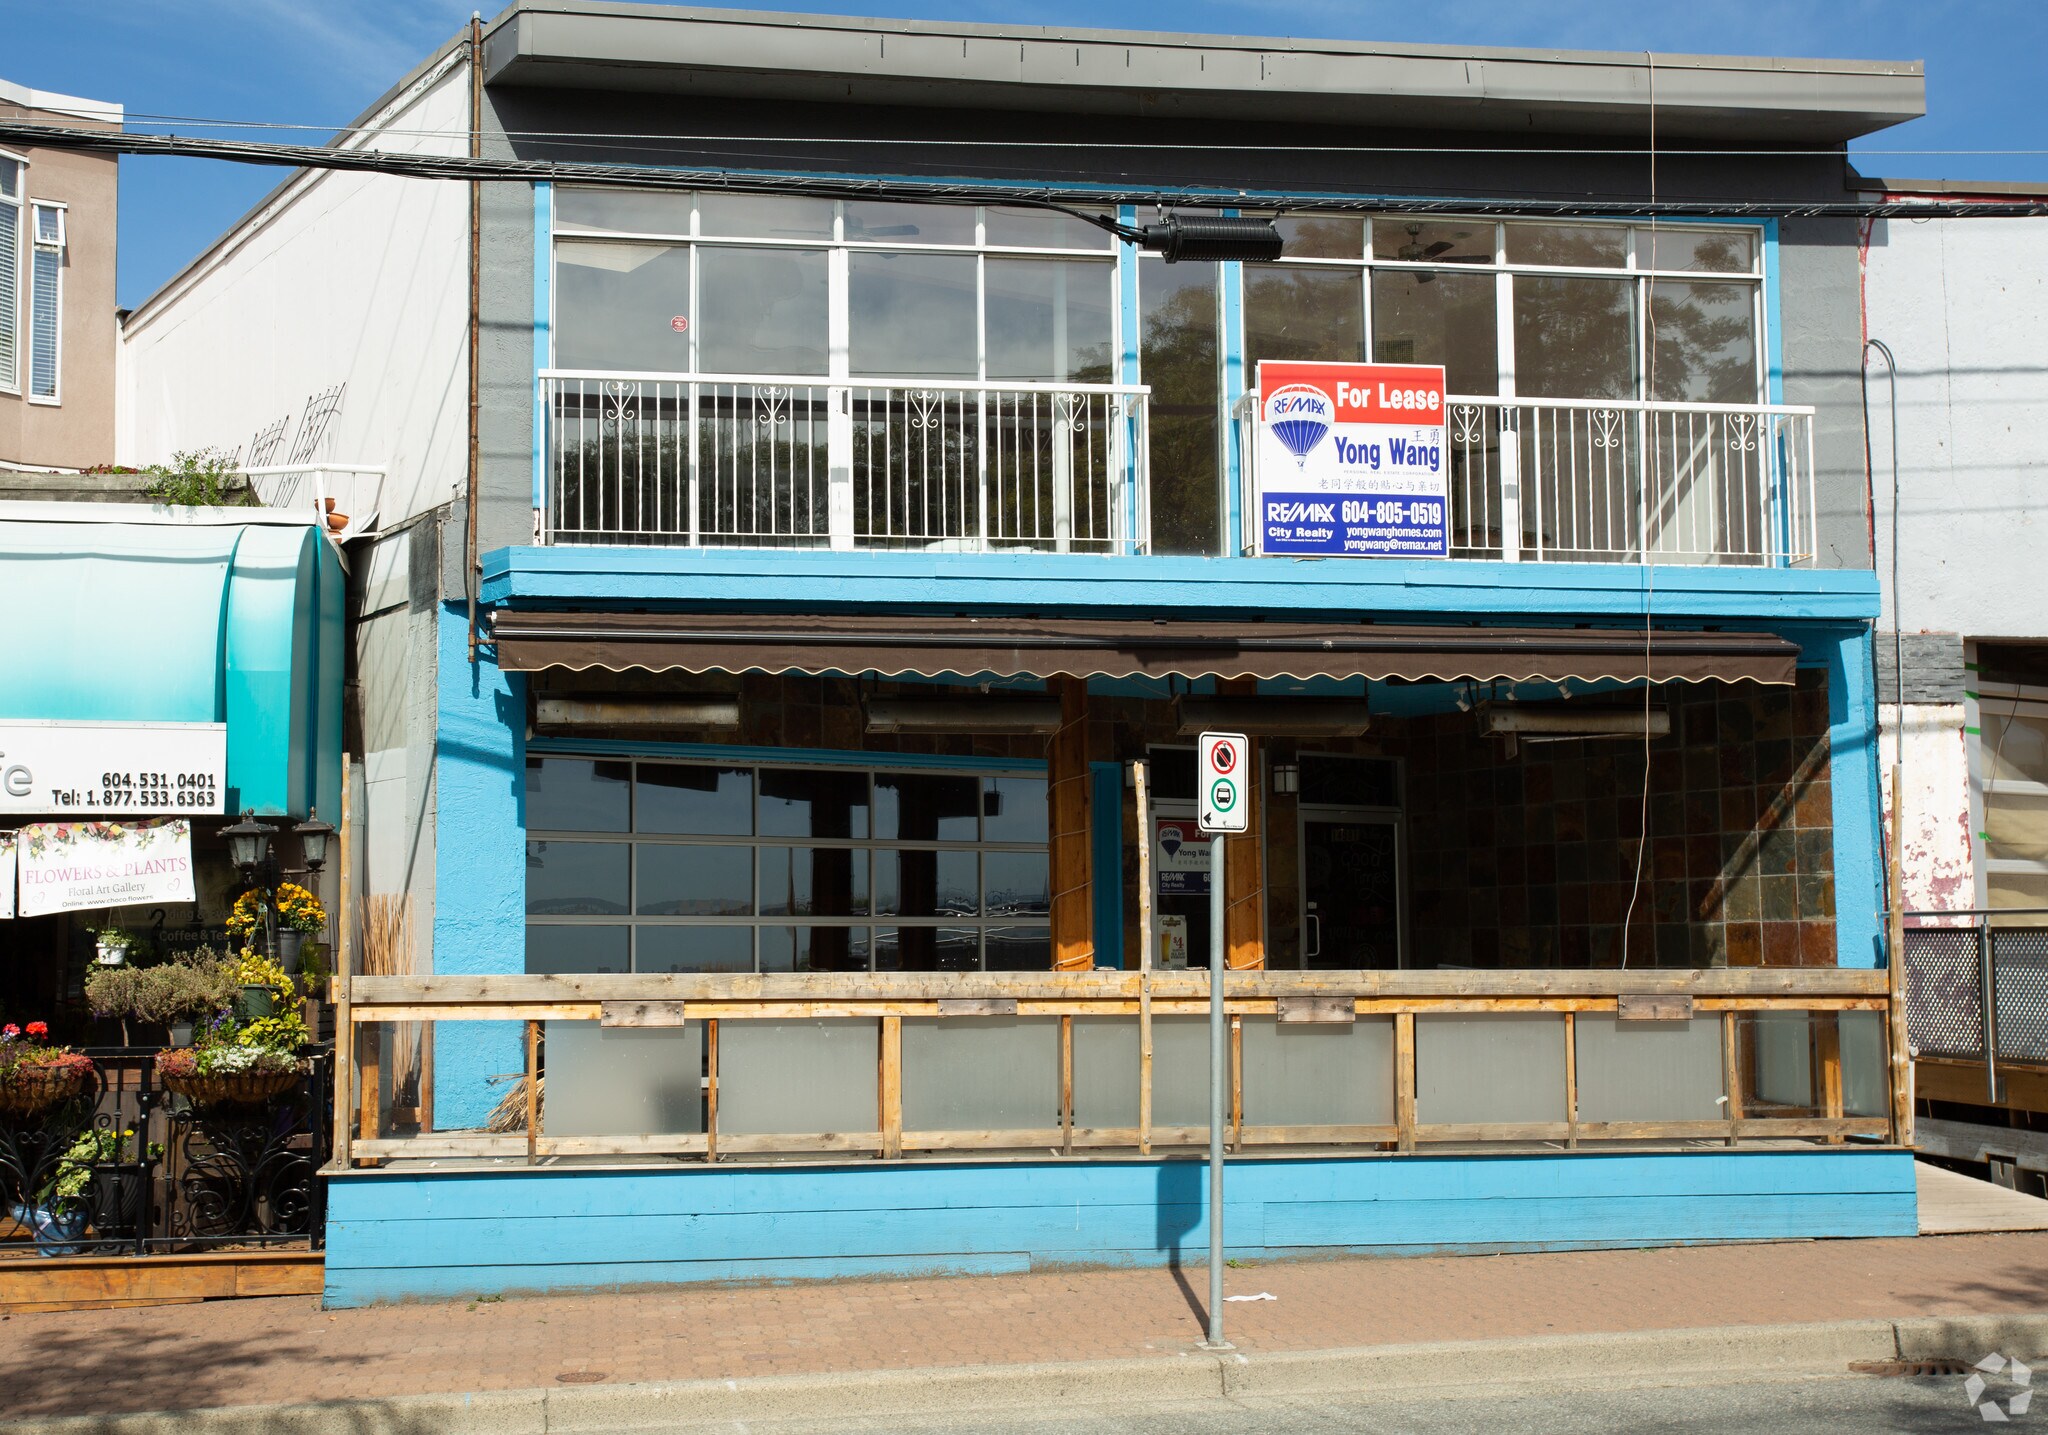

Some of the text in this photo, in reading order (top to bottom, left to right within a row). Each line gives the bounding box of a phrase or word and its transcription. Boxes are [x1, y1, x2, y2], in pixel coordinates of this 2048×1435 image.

[1336, 382, 1440, 411] For Lease
[1274, 396, 1326, 416] RE/MAX
[1411, 428, 1440, 445] 王勇
[1334, 436, 1440, 472] Yong Wang
[1268, 500, 1442, 525] RE/MAX 604-805-0519
[1268, 527, 1333, 539] City Realty
[1346, 526, 1442, 538] yongwanghomes.com
[1344, 539, 1442, 551] yongwang@remax.net
[102, 772, 215, 789] 604.531.0401
[52, 789, 215, 807] Tel: 1.877.533.6363
[1195, 829, 1211, 838] For
[1178, 850, 1197, 858] Yong
[25, 856, 187, 884] FLOWERS & PLANTS
[68, 882, 145, 897] Floral Art Gallery
[160, 930, 230, 941] Coffee & Tea
[1172, 936, 1184, 949] $4
